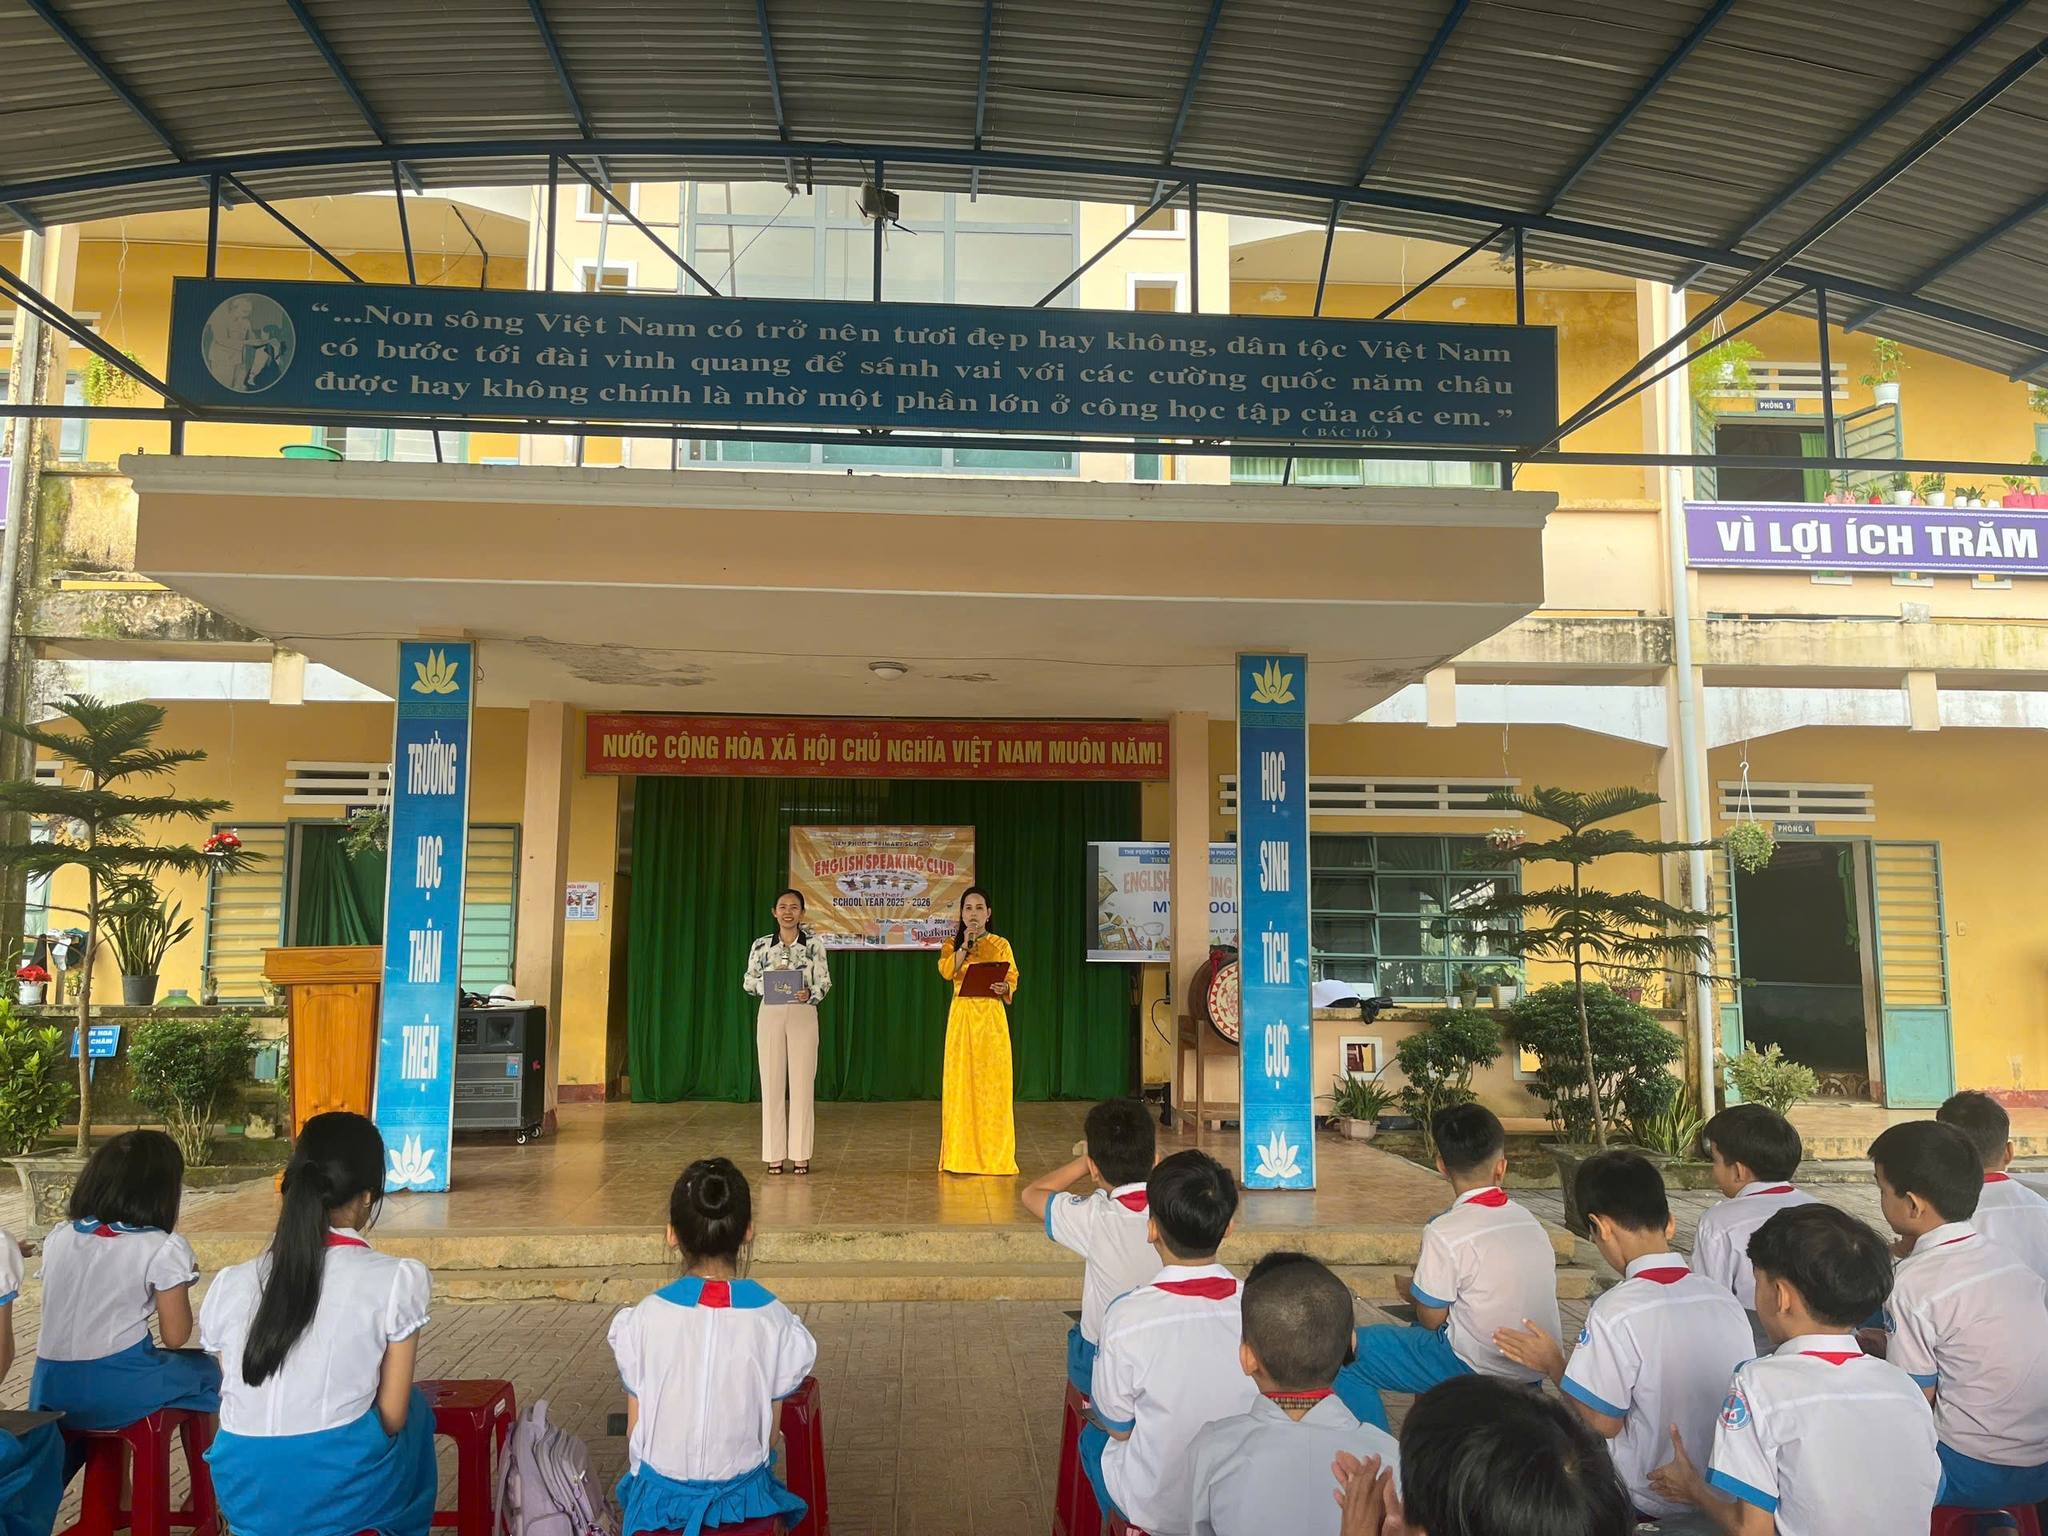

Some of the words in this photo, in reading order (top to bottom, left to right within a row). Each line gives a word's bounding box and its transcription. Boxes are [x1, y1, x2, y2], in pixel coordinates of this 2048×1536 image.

[445, 310, 523, 335] sông
[536, 313, 607, 337] Việt
[619, 316, 696, 337] Nam
[707, 319, 743, 339] có
[757, 319, 807, 340] trở
[819, 323, 881, 343] nên
[894, 326, 956, 345] tươi
[967, 328, 1028, 351] đẹp
[1039, 330, 1095, 353] hay
[1107, 331, 1216, 357] không,
[1227, 336, 1287, 356] dân
[1299, 339, 1347, 361] tộc
[1359, 340, 1426, 362] Việt
[1437, 343, 1512, 362] Nam
[320, 338, 358, 357] có
[377, 339, 458, 361] bước
[475, 344, 520, 364] tới
[536, 347, 589, 367] đài
[605, 350, 675, 369] vinh
[691, 354, 791, 377] quang
[805, 351, 846, 373] để
[860, 357, 938, 377] sánh
[955, 360, 1001, 379] vai
[1017, 362, 1065, 381] với
[1080, 364, 1134, 382] các
[1149, 366, 1247, 392] cường
[1261, 368, 1337, 393] quốc
[1352, 374, 1423, 392] năm
[1437, 375, 1513, 394] châu
[315, 371, 398, 395] được
[410, 375, 470, 400] hay
[483, 378, 589, 405] không
[600, 383, 691, 403] chính
[703, 385, 731, 404] là
[745, 386, 808, 405] nhờ
[819, 389, 882, 411] một
[896, 388, 978, 413] phần
[989, 394, 1040, 413] lớn
[1051, 392, 1071, 414] ở
[1081, 398, 1158, 421] công
[1169, 399, 1225, 422] học
[1237, 402, 1291, 426] tập
[1301, 401, 1358, 422] của
[1369, 405, 1424, 424] các
[1716, 515, 1755, 552] VÌ
[1769, 519, 1832, 559] LỢI
[1846, 518, 1914, 556] ÍCH
[1925, 520, 2039, 558] TRĂM
[408, 730, 457, 795] TRƯỜNG
[603, 730, 658, 758] NƯỚC
[665, 731, 719, 764] CỘNG
[726, 731, 764, 760] HÒA
[771, 732, 797, 760] XÃ
[804, 734, 836, 766] HỘI
[842, 732, 881, 762] CHỦ
[887, 736, 946, 762] NGHĨA
[952, 736, 993, 768] VIỆT
[998, 741, 1042, 763] NAM
[1049, 737, 1106, 764] MUÔN
[1112, 737, 1163, 764] NĂM!
[1261, 751, 1286, 813] HỌC
[416, 835, 443, 900] HỌC
[814, 855, 864, 877] ENGLISH
[865, 852, 925, 871] SPEAKING
[926, 857, 956, 877] CLUB
[1123, 870, 1170, 894] ENGLISH
[1209, 877, 1233, 898] ING
[1260, 840, 1289, 892] SINH
[833, 897, 863, 907] SCHOOL
[865, 897, 884, 907] YEAR
[886, 897, 905, 907] 2025
[1209, 902, 1238, 914] OOL
[408, 918, 443, 983] THÂN
[911, 927, 957, 942] Speaking
[1262, 921, 1290, 984] TÍCH
[402, 1014, 439, 1092] THIỆN
[1265, 1019, 1290, 1089] CỰC
